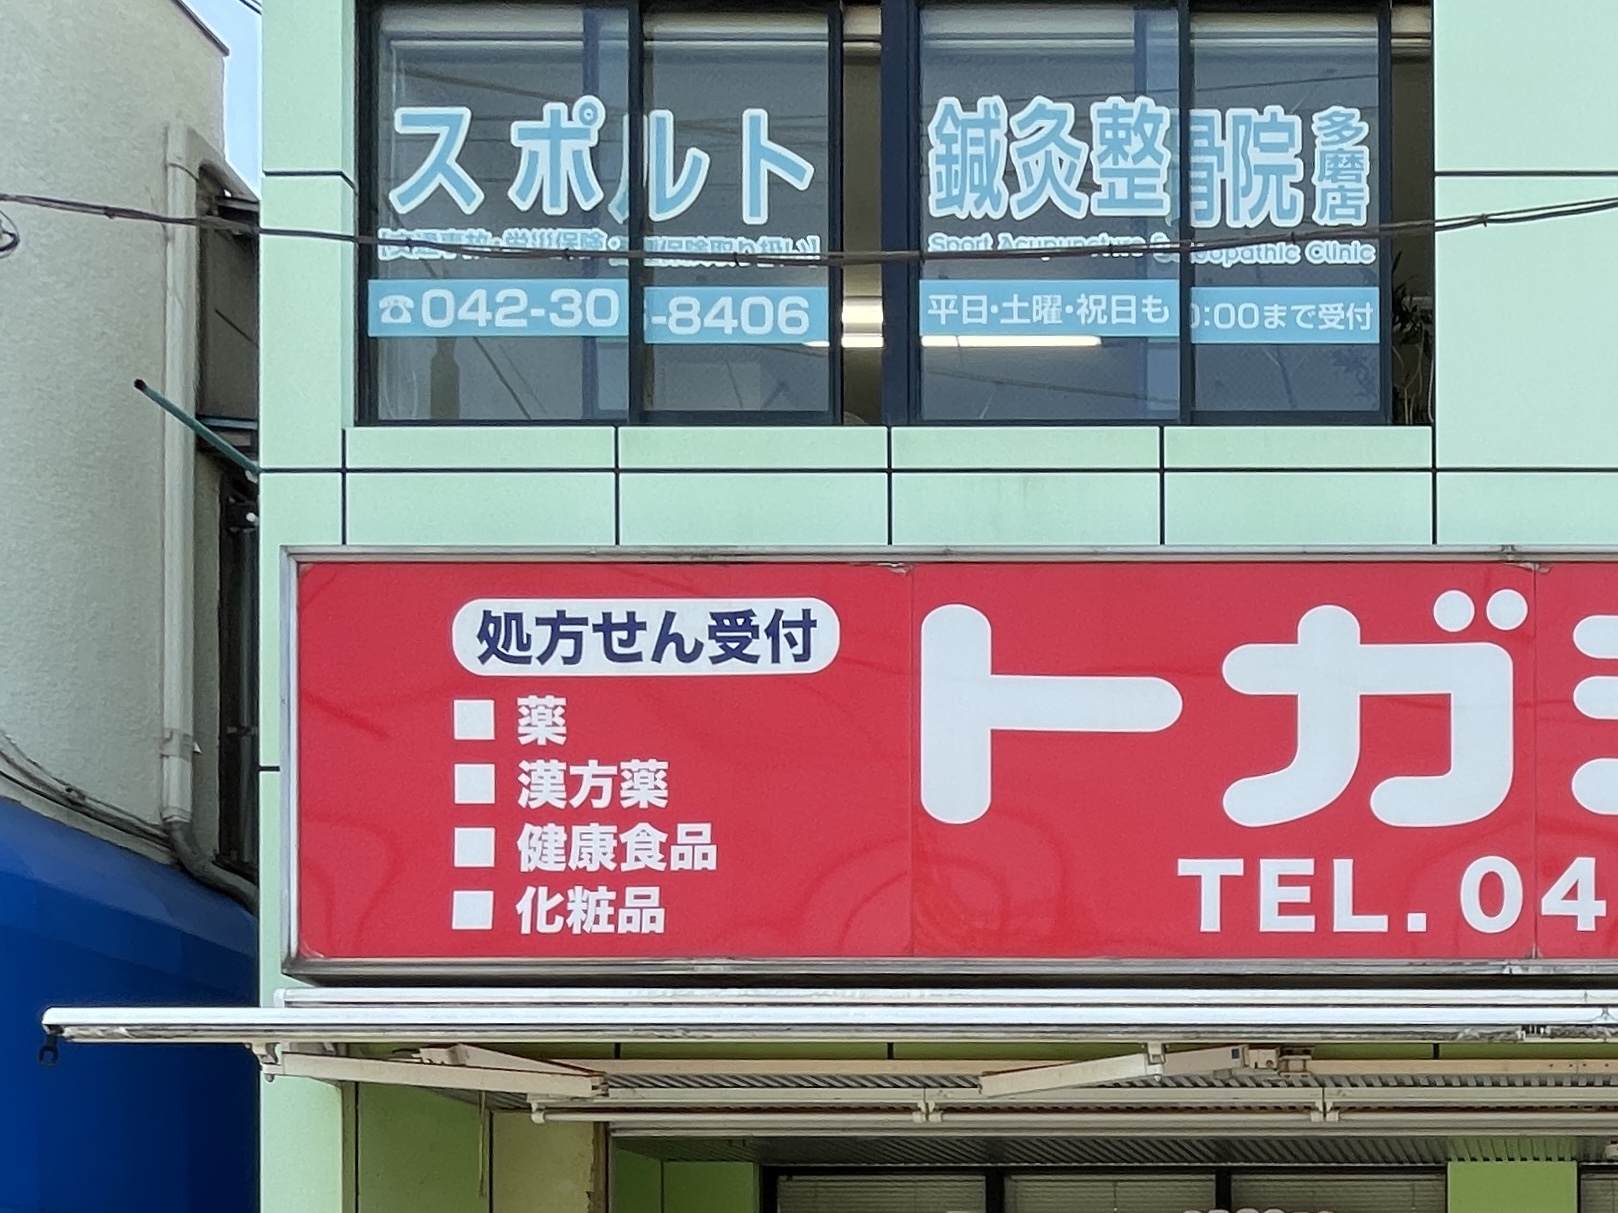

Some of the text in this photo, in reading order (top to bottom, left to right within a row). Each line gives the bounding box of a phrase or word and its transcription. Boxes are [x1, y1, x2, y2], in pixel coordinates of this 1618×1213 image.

[389, 95, 815, 224] スポルト
[928, 95, 1304, 228] 鍼灸整骨院
[1312, 105, 1369, 225] 多磨店
[1305, 240, 1376, 264] Clinic
[476, 608, 818, 665] 処方せん受付
[517, 696, 567, 745] 薬
[517, 759, 669, 808] 漢方薬
[516, 822, 718, 872] 健康食品
[515, 886, 666, 934] 化粧品
